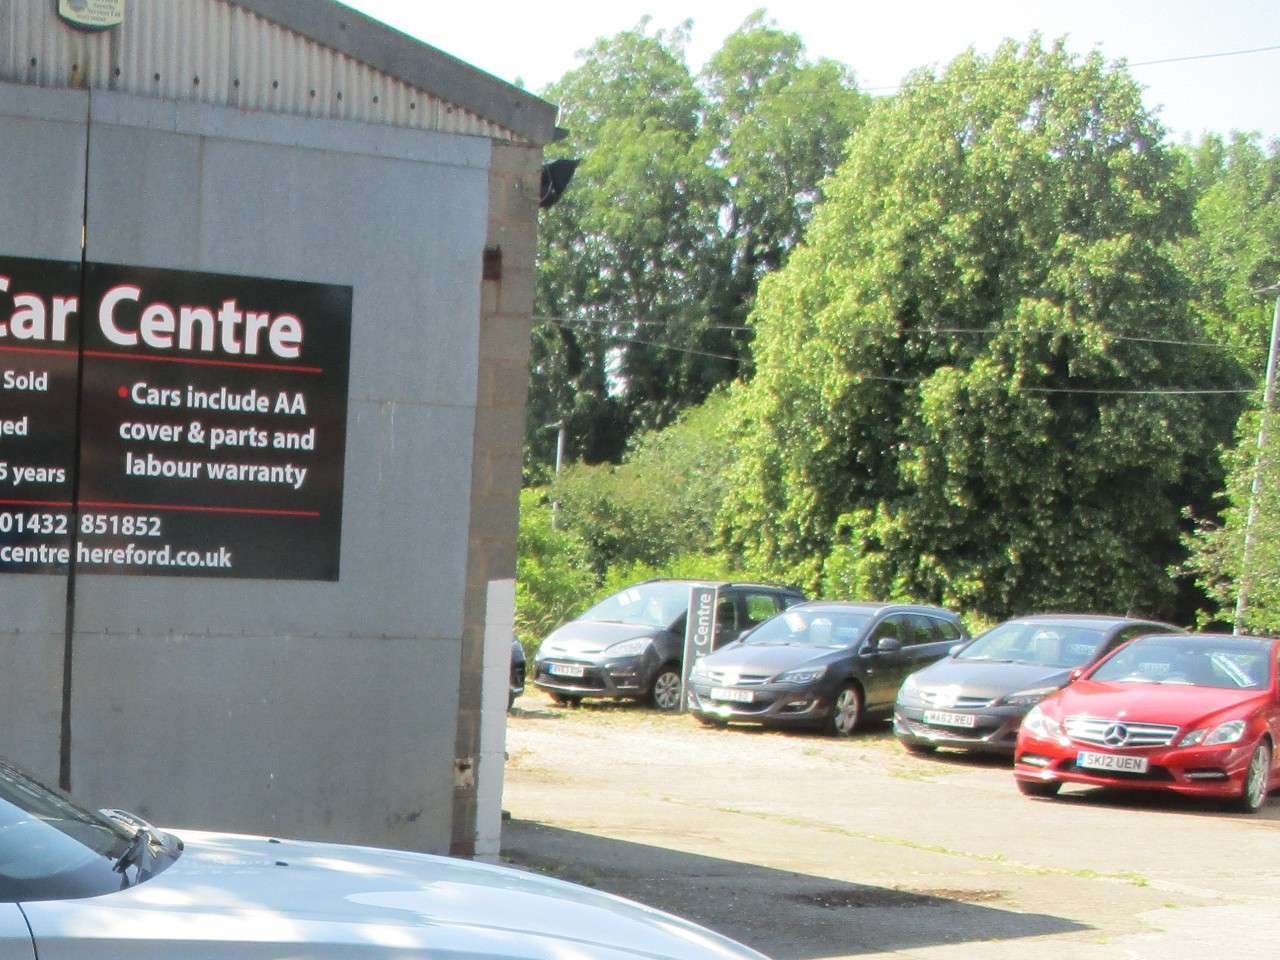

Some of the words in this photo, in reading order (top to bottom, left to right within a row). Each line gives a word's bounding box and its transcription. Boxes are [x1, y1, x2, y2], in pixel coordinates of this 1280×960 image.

[99, 286, 302, 358] Centre
[4, 370, 47, 391] Sold
[132, 382, 181, 406] Cars
[187, 386, 269, 412] include
[274, 392, 306, 415] AA
[120, 423, 182, 442] cover
[188, 421, 205, 443] &
[210, 427, 268, 449] parts
[273, 428, 315, 450] and
[13, 467, 65, 485] years
[126, 452, 202, 478] labour
[207, 463, 307, 489] warranty
[0, 512, 67, 534] 01432
[81, 514, 160, 536] 851852
[694, 593, 712, 646] Centre
[1087, 754, 1113, 767] SK12
[1116, 757, 1142, 770] UEN
